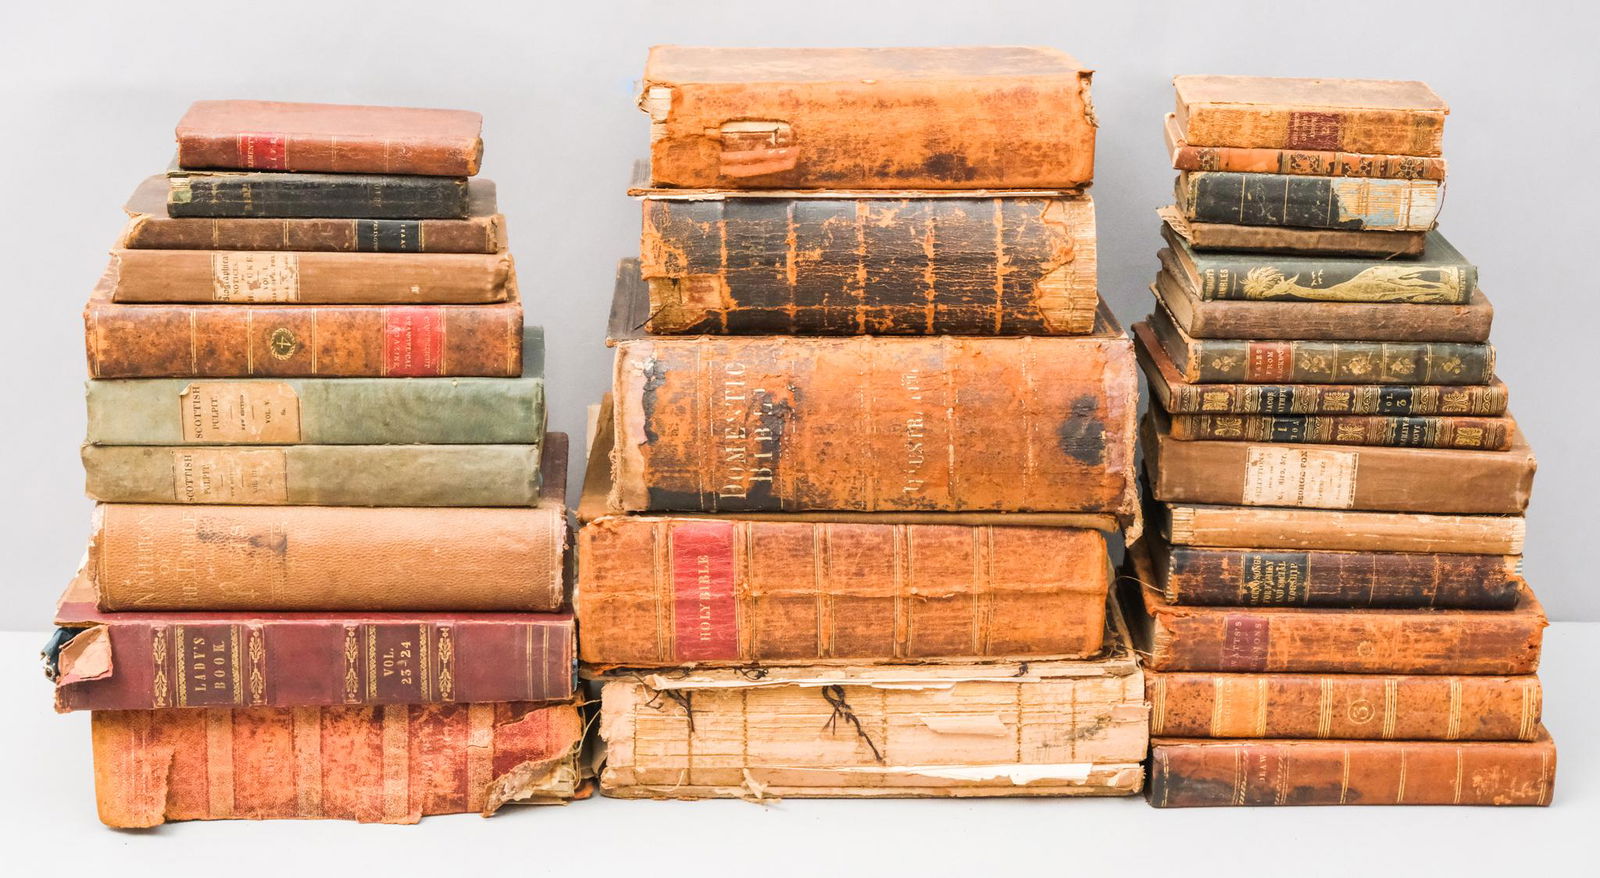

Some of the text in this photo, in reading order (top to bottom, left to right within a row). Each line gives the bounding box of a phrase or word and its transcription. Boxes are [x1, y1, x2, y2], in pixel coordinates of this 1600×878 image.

[276, 336, 292, 349] 4
[192, 386, 204, 439] SCOTTISH
[1384, 393, 1393, 413] VOL
[1397, 399, 1407, 407] 3
[719, 362, 747, 500] DOMESTIC
[1290, 420, 1300, 440] VOL
[183, 454, 195, 502] SCOTTISH
[1296, 450, 1308, 506] GEORGE FOX
[1253, 555, 1262, 580] SONGS
[697, 554, 712, 642] HOLY BIBLE
[193, 637, 207, 691] LADY'S
[383, 648, 394, 676] VOL.
[400, 640, 412, 685] 23-24
